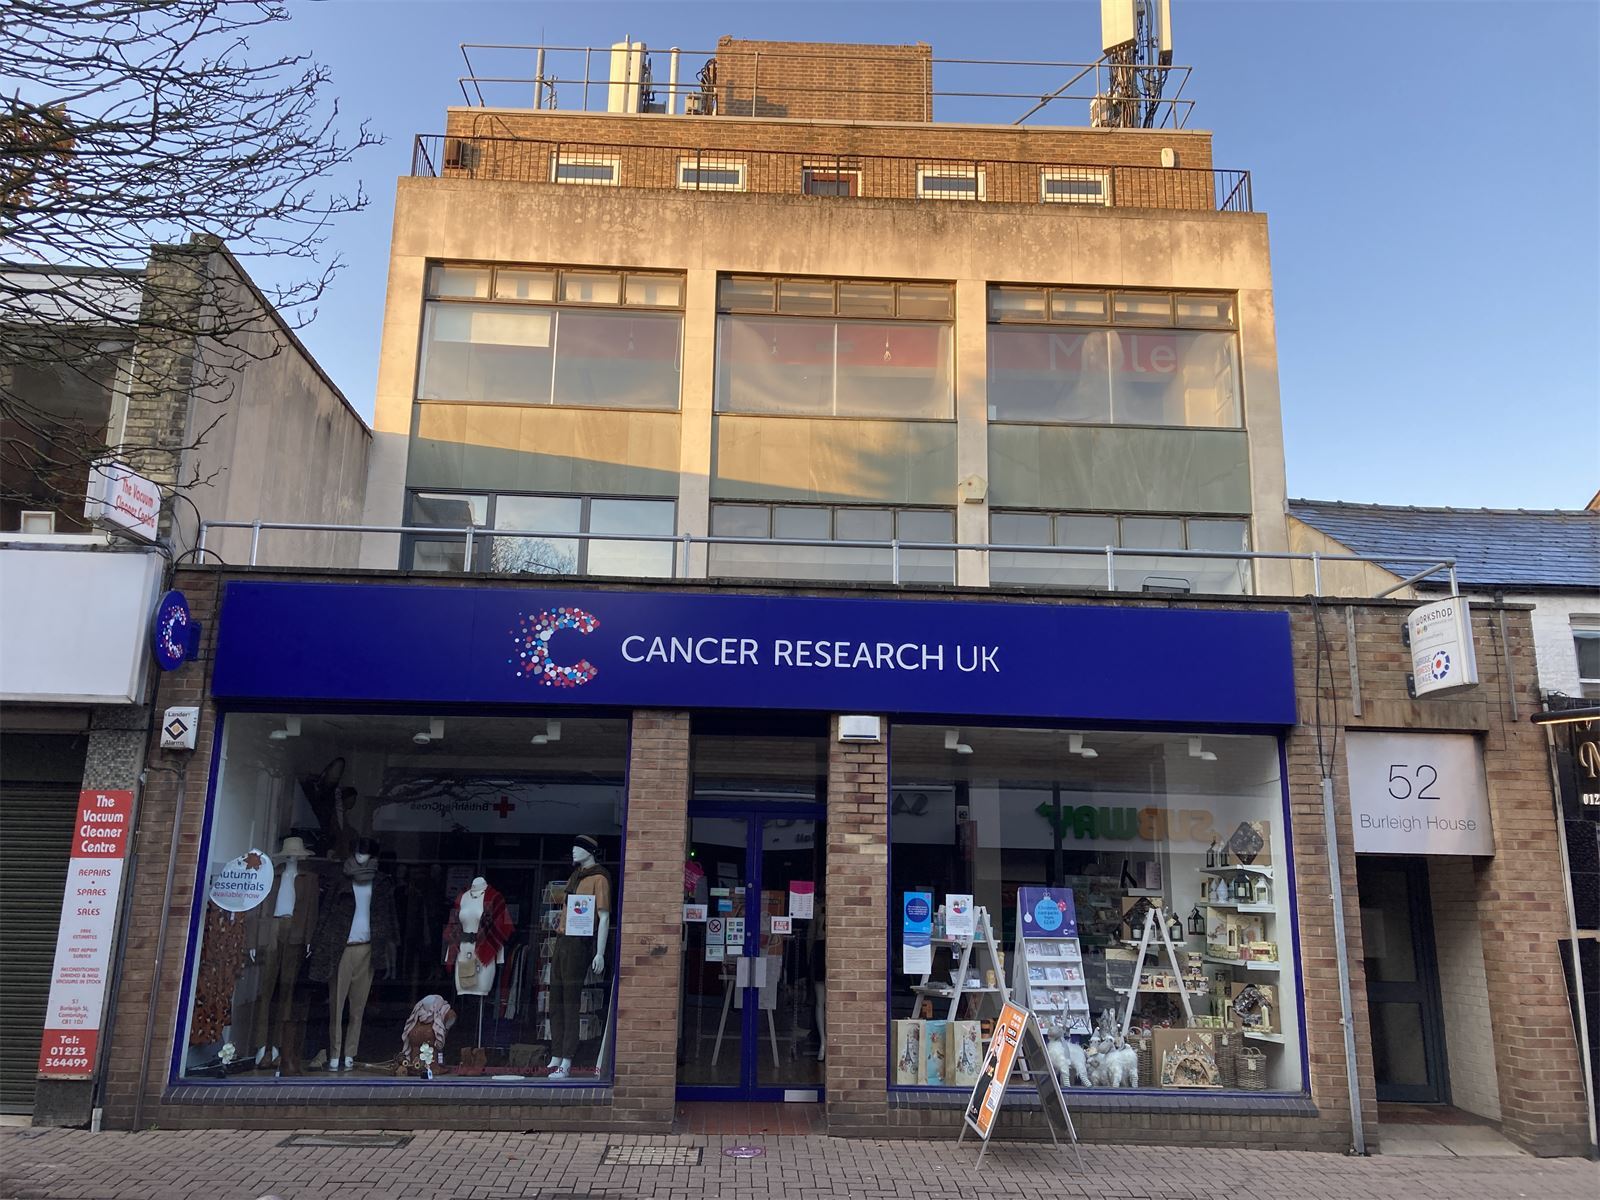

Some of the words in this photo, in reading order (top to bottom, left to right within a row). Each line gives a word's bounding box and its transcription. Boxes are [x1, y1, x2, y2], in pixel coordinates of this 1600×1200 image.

[122, 476, 132, 496] The
[133, 483, 154, 508] Vacuum
[620, 634, 759, 666] CANCER
[774, 640, 944, 672] RESEARCH
[956, 645, 1001, 673] UK
[1388, 764, 1441, 800] 52
[96, 794, 115, 808] The
[82, 809, 124, 823] Vacuum
[1360, 813, 1422, 833] Burleigh
[1426, 816, 1477, 831] House
[80, 824, 122, 838] Cleaner
[80, 840, 116, 853] Centre
[78, 868, 112, 877] REPAIRS
[214, 880, 264, 892] essentials
[212, 890, 243, 898] available
[76, 908, 100, 916] SALES
[60, 1035, 79, 1044] Tel:
[50, 1047, 86, 1055] 01223
[45, 1058, 88, 1067] 364499
